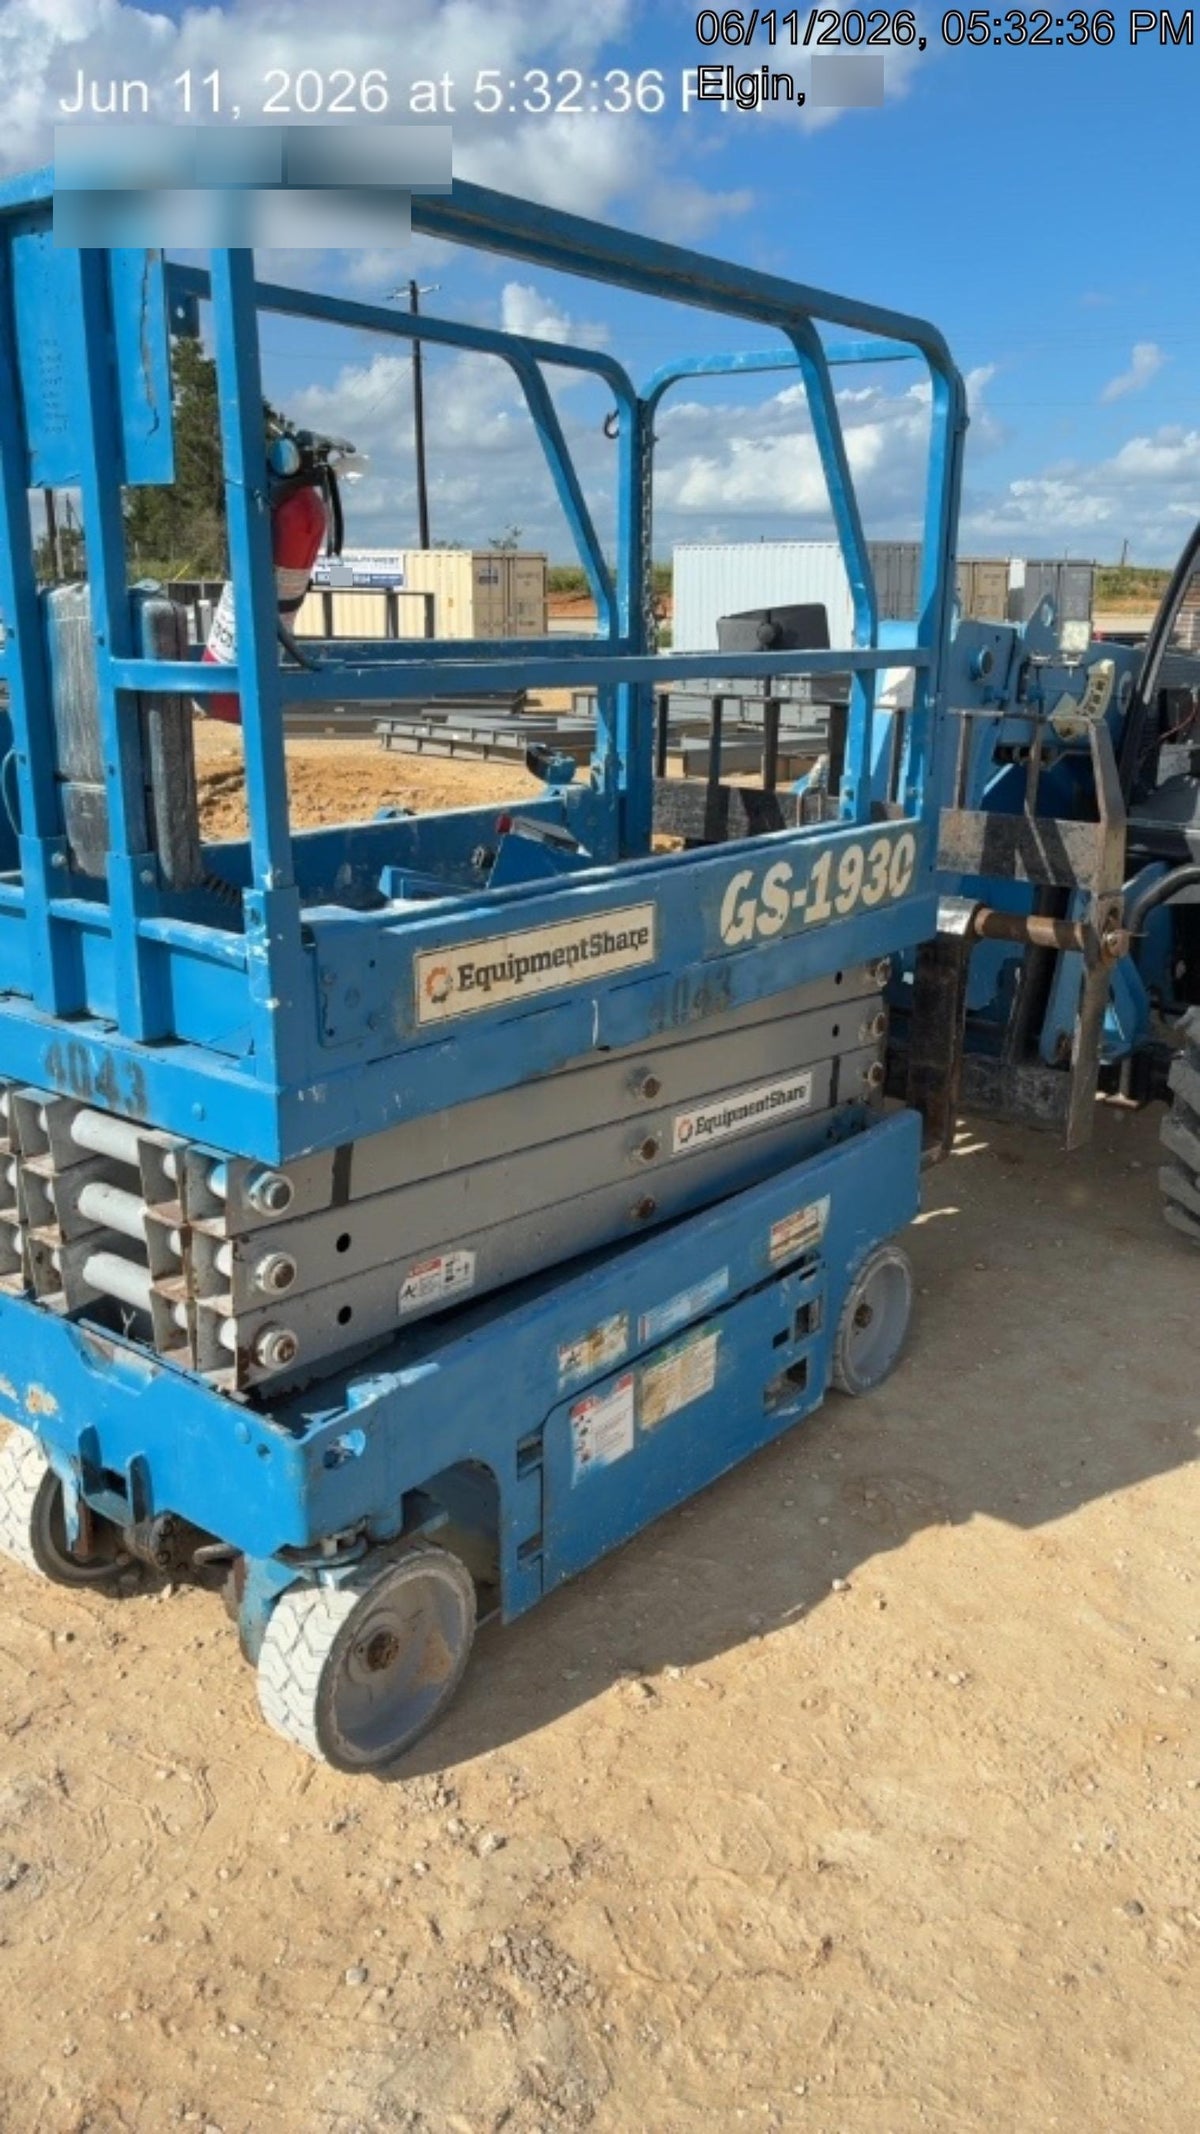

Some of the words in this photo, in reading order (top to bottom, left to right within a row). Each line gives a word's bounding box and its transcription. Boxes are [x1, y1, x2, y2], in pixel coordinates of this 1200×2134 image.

[720, 833, 916, 946] GS-1930
[457, 926, 649, 992] EquipmentShare
[694, 1085, 808, 1136] EquipmentShare
